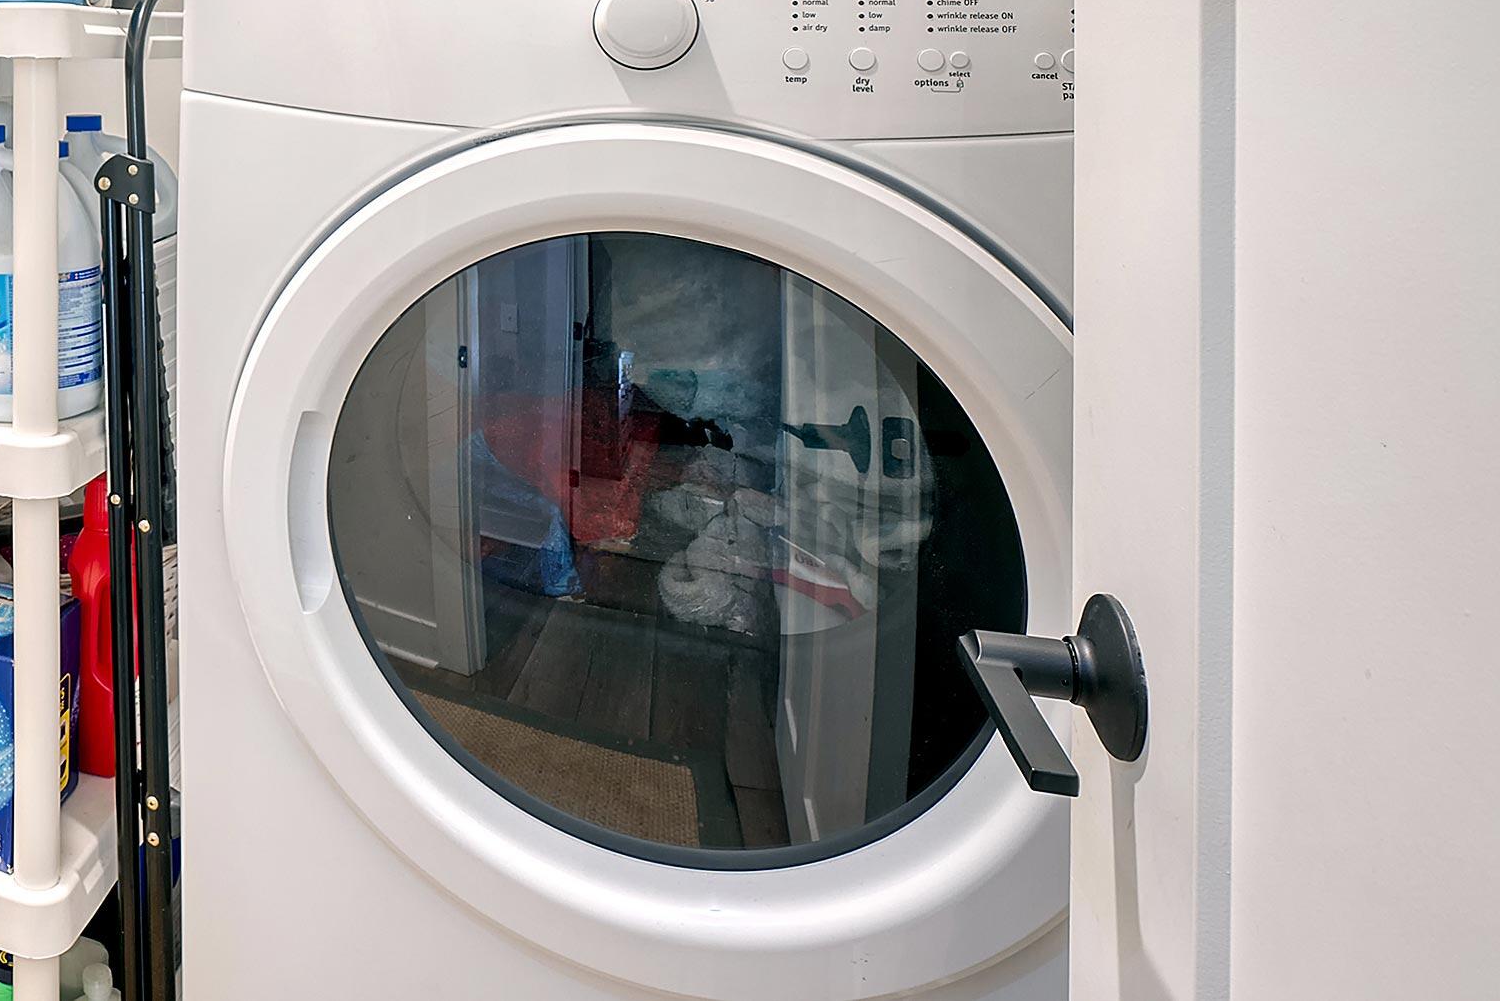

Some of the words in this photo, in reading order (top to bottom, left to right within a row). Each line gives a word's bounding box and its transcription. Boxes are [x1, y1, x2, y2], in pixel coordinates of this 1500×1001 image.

[815, 24, 828, 32] dry
[868, 24, 891, 33] damp
[937, 25, 968, 33] wrinkle
[970, 25, 999, 33] release
[1001, 25, 1017, 33] OFF
[785, 76, 808, 84] temp
[1031, 72, 1059, 80] cancel
[855, 77, 870, 86] dry
[914, 78, 949, 88] options
